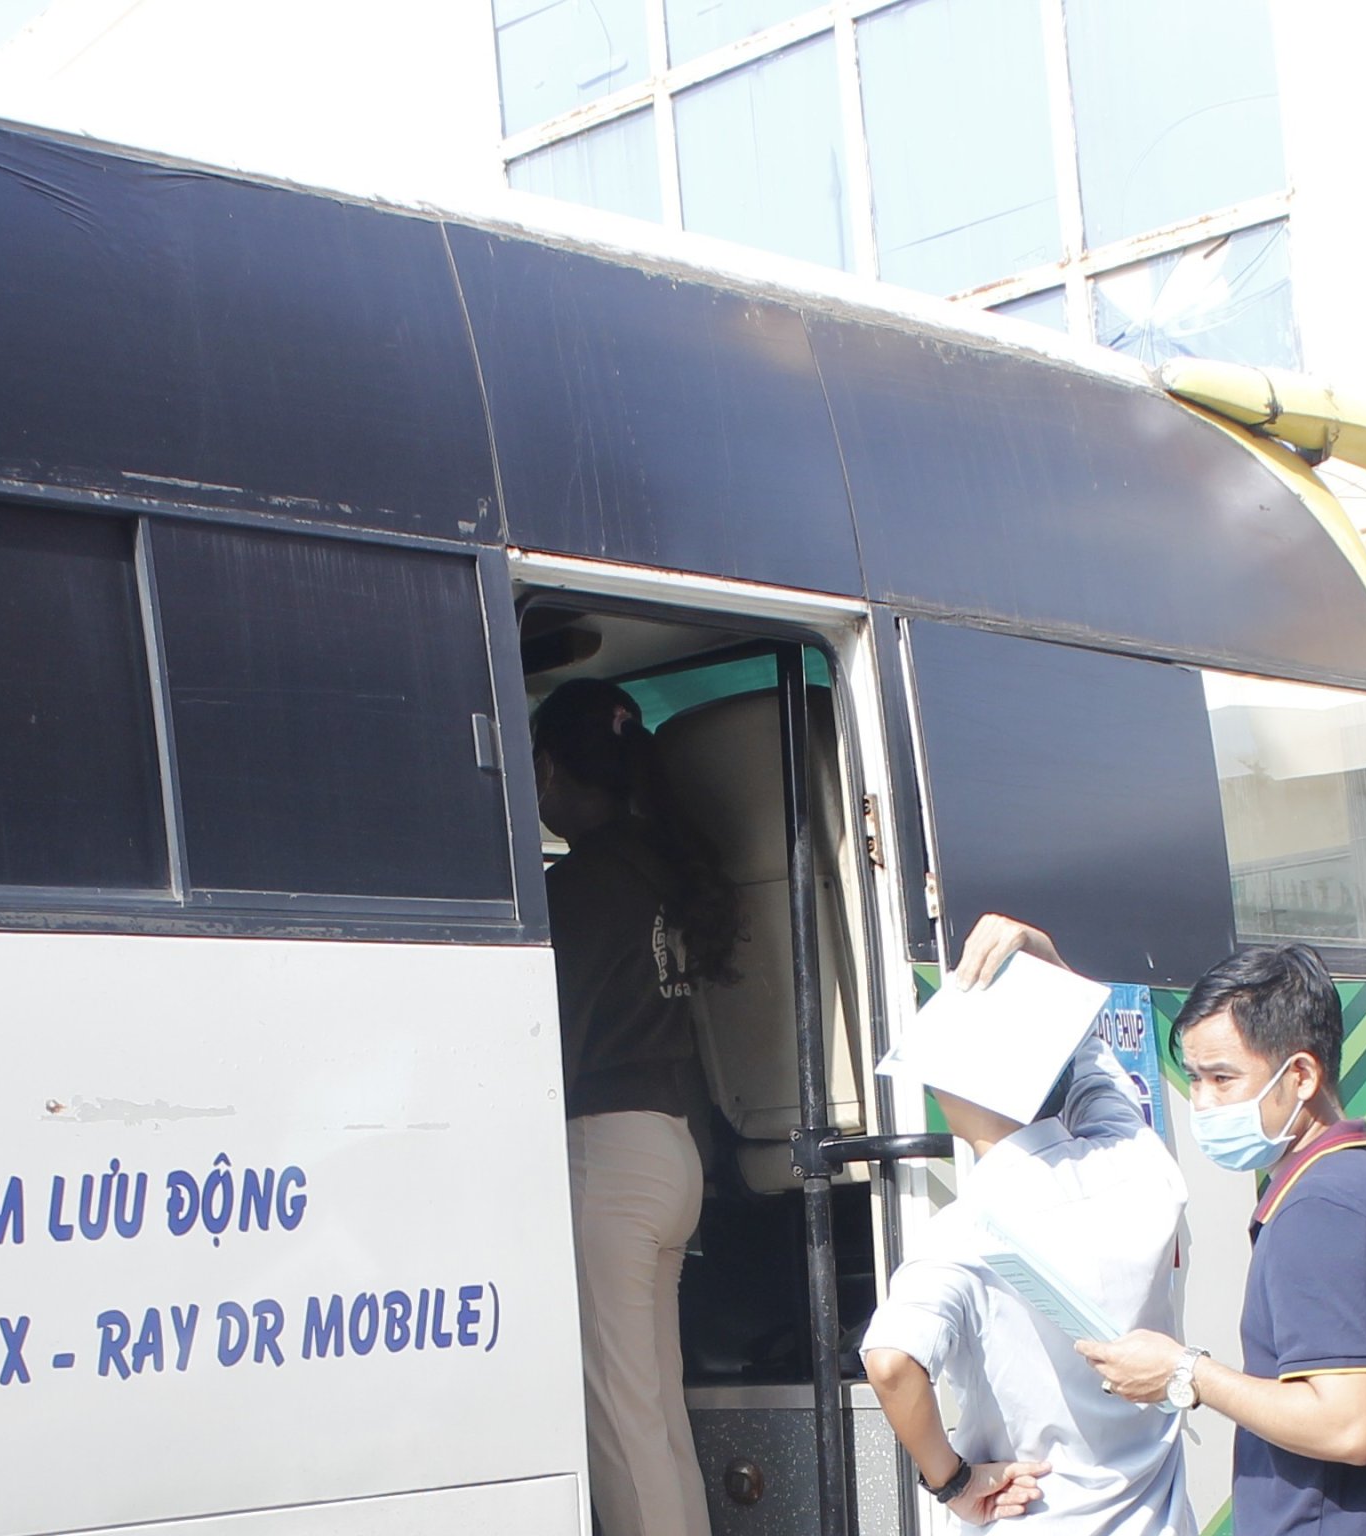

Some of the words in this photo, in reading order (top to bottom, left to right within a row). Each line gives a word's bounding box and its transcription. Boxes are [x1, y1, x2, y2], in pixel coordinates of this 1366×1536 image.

[47, 1157, 148, 1242] LƯU
[166, 1152, 308, 1248] ĐỘNG
[95, 1303, 200, 1381] RAY
[215, 1299, 287, 1368] DR
[301, 1281, 501, 1362] MOBILE)
